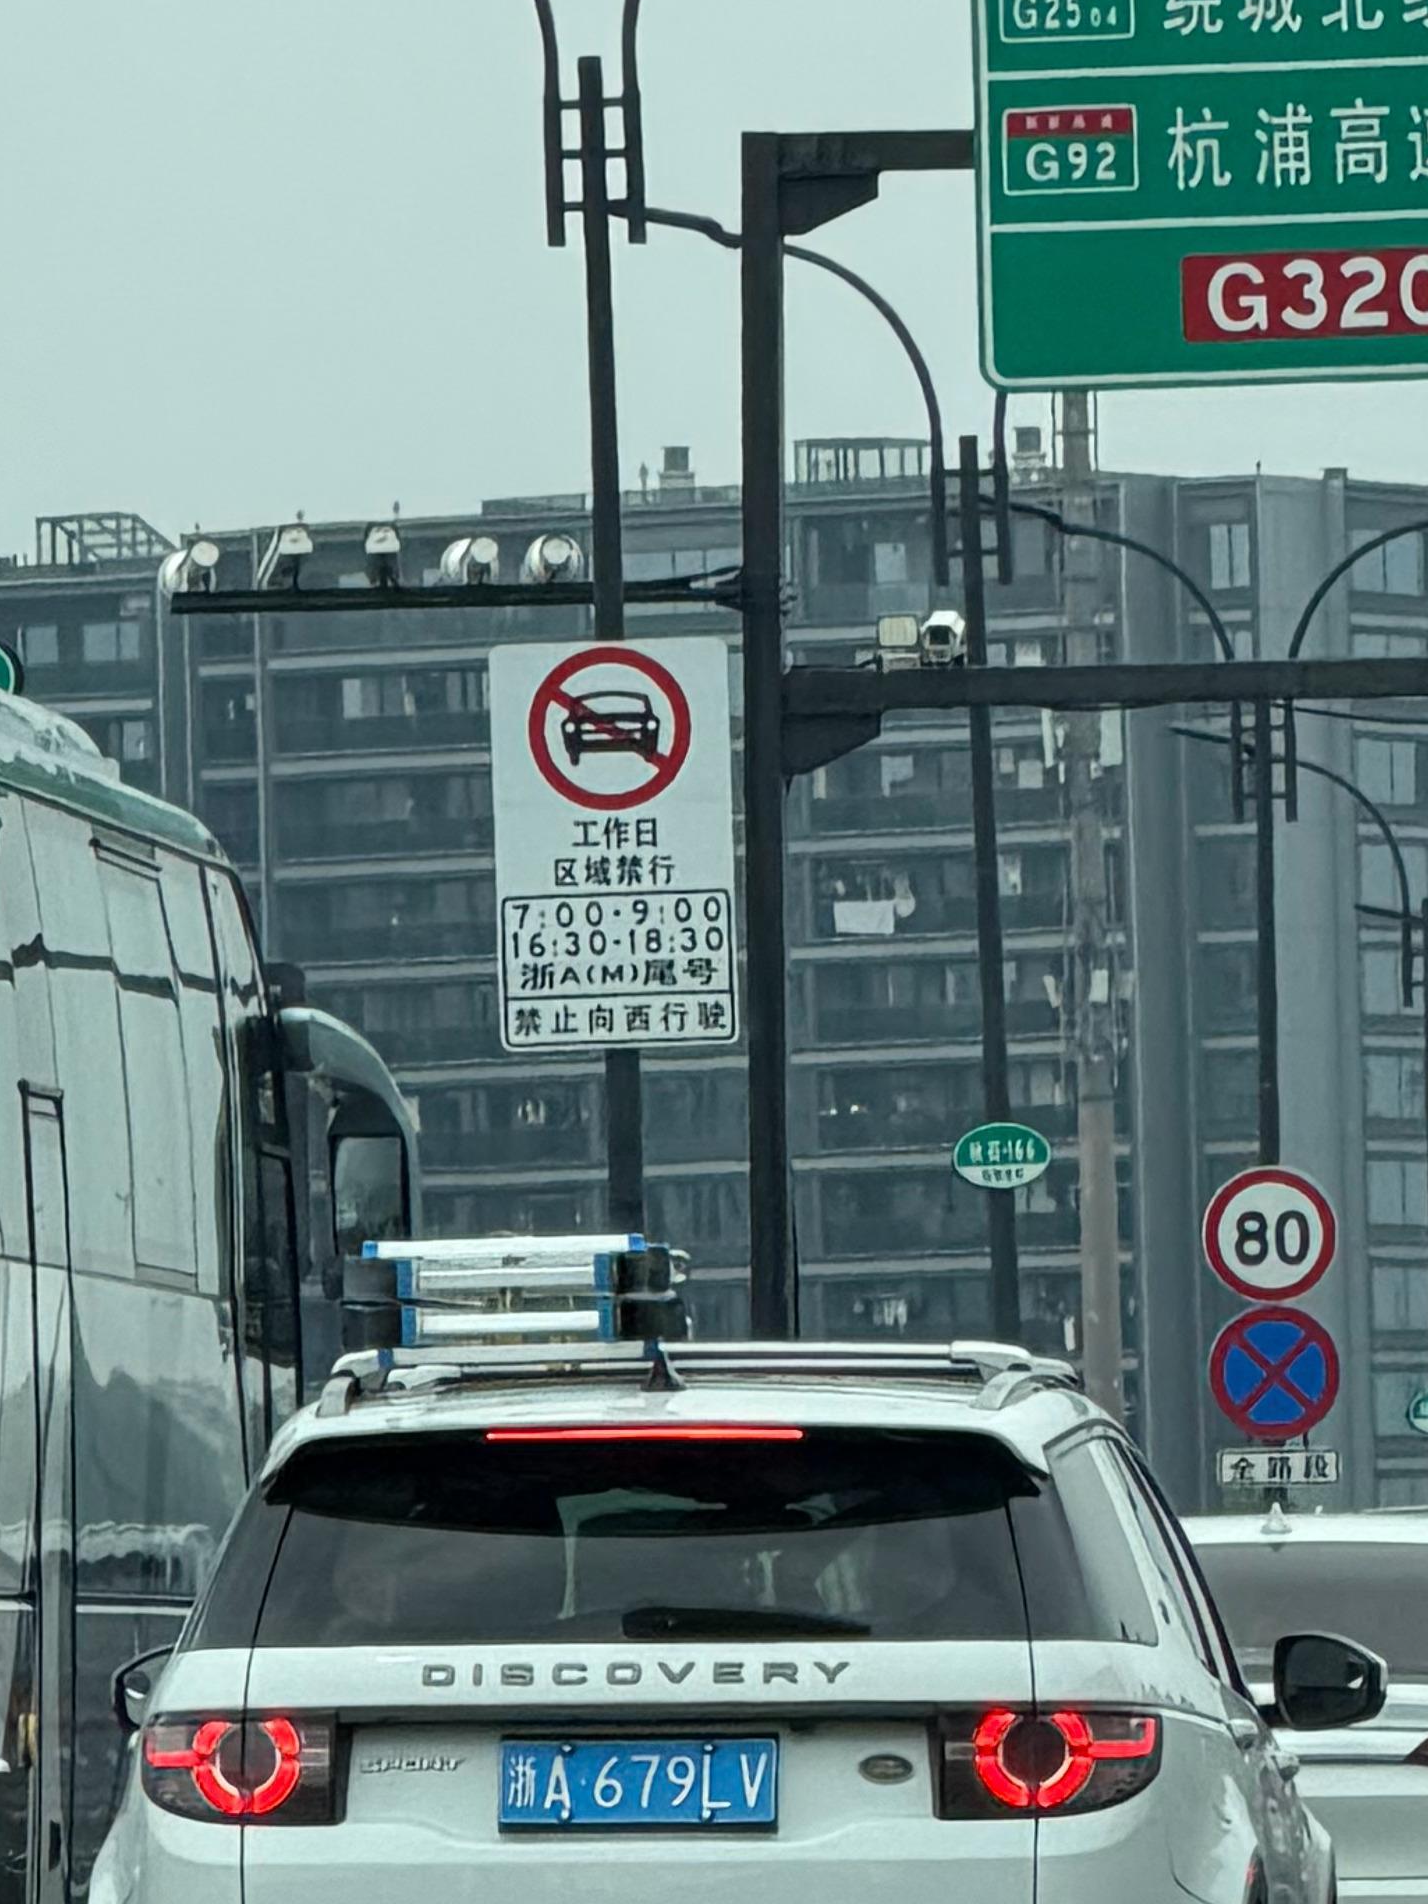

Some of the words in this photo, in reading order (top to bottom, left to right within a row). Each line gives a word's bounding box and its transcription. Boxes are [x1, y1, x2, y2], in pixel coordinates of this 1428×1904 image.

[1025, 142, 1116, 181] G92
[572, 817, 657, 850] 工作日
[554, 855, 675, 886] 区域禁行
[513, 926, 724, 958] 16:30-18:30
[514, 1000, 726, 1037] 禁止向西行驶
[1234, 1210, 1311, 1266] 80
[421, 1661, 850, 1687] DISCOVERY
